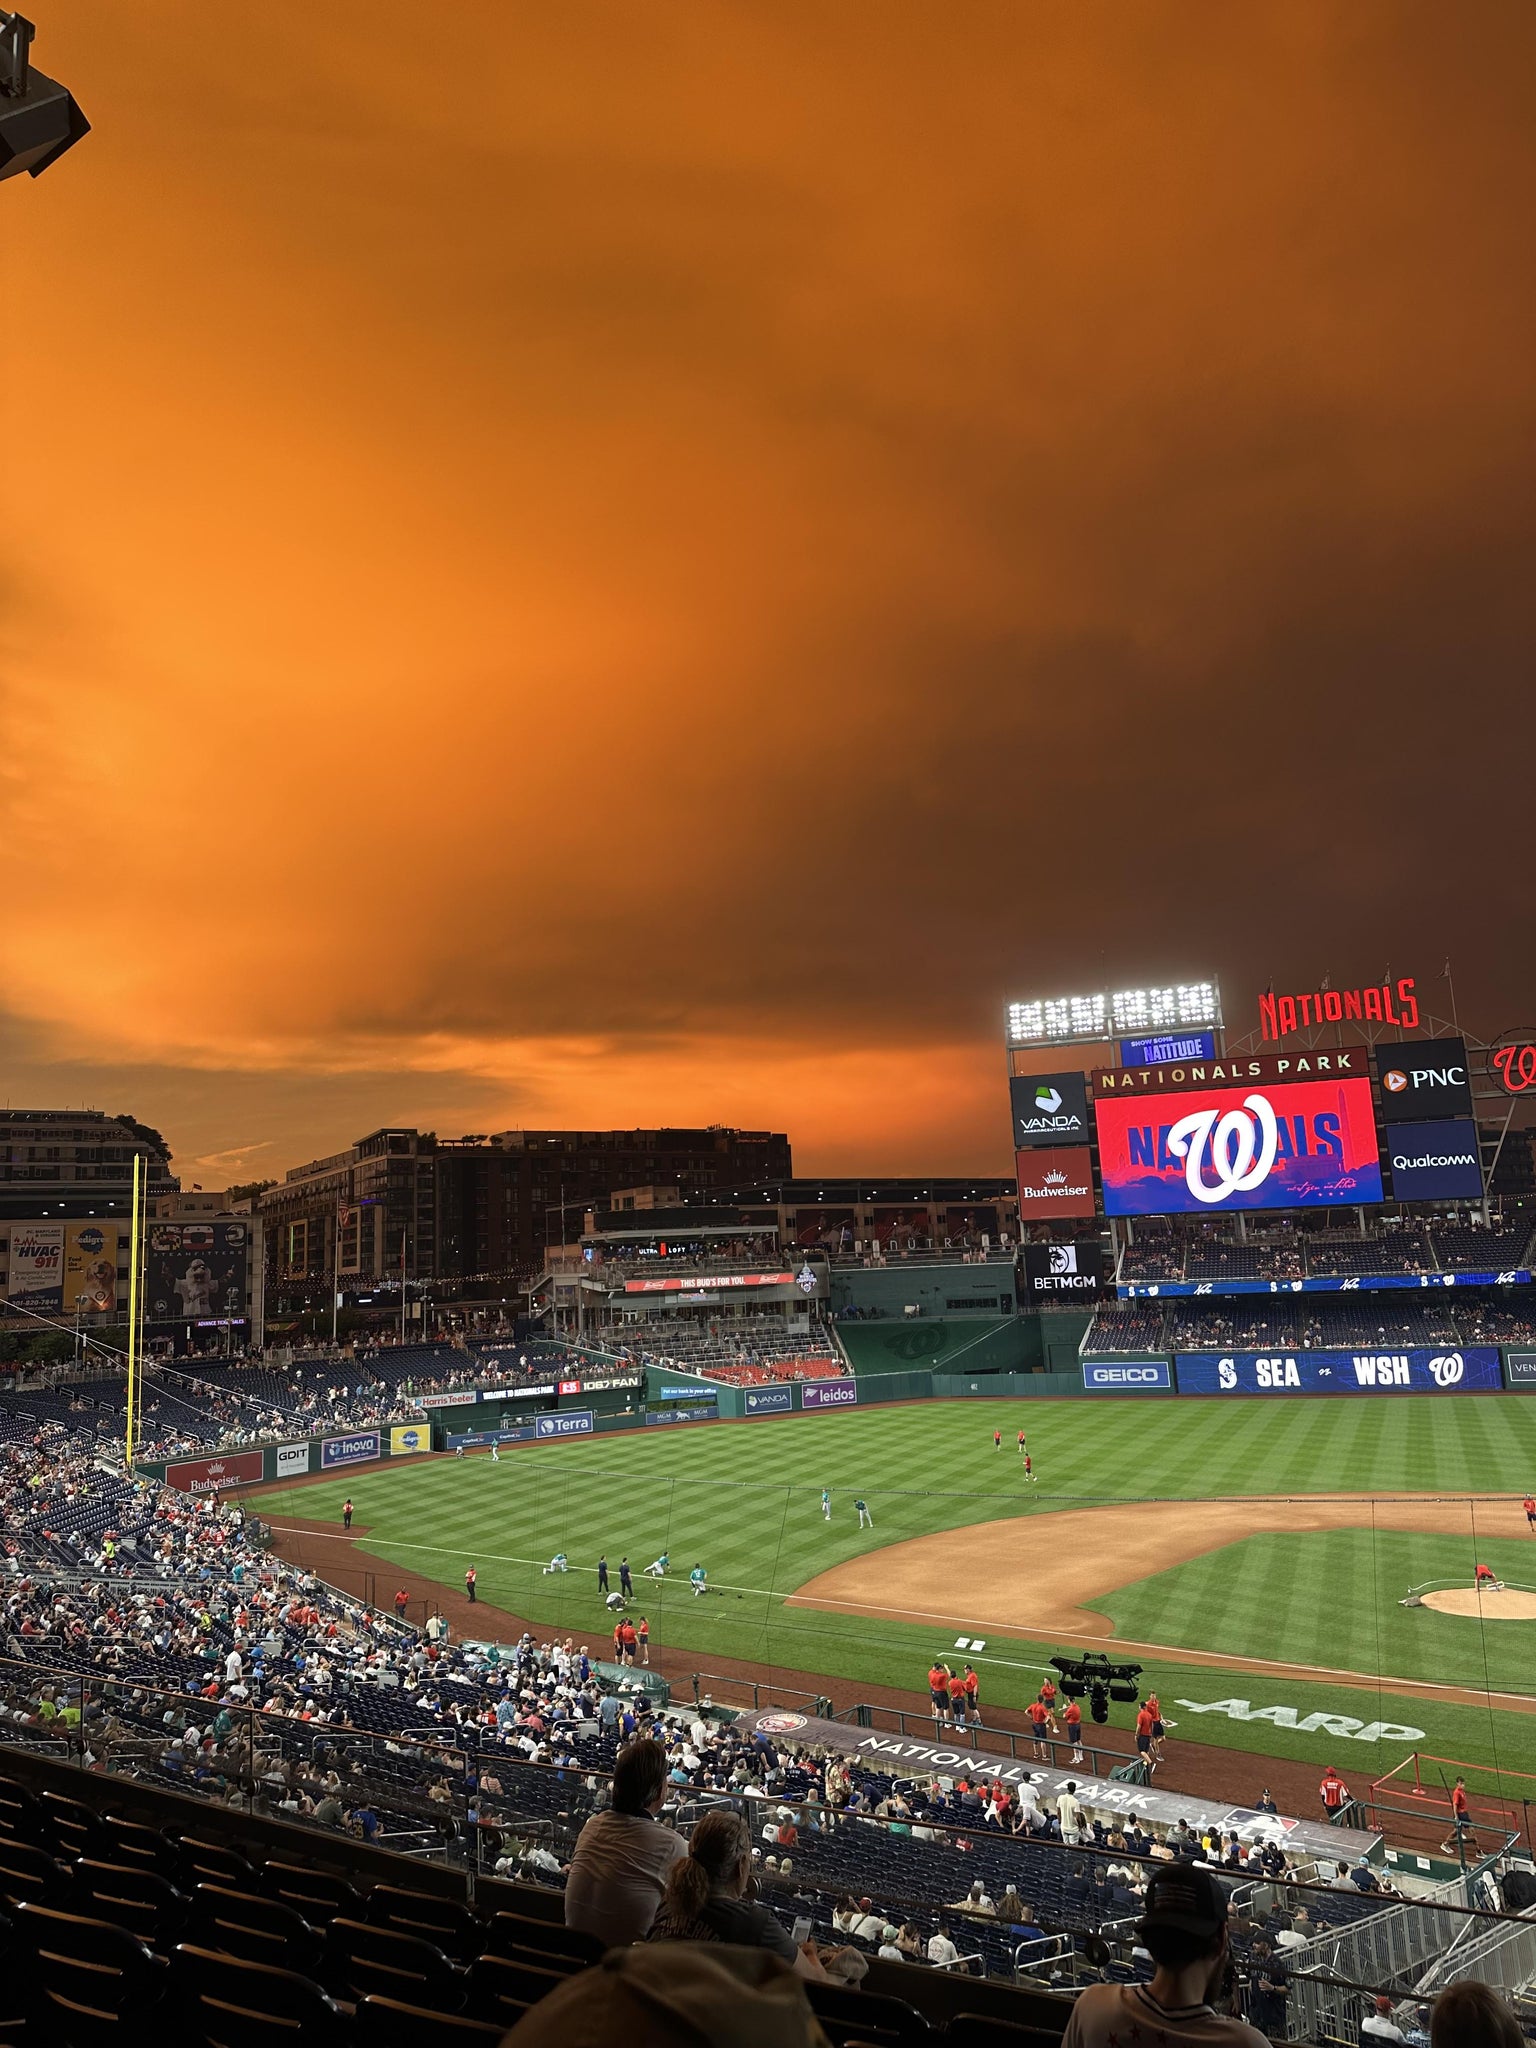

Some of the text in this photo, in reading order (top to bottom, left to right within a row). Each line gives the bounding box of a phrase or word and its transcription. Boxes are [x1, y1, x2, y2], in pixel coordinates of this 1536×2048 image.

[1258, 978, 1419, 1041] NATIONALS
[1131, 1036, 1173, 1047] SHOW SOME
[1144, 1039, 1203, 1062] NATITUDE
[1102, 1054, 1352, 1088] NATIONALS PARK
[1410, 1067, 1466, 1089] PNC
[1020, 1115, 1081, 1129] VANDA
[1127, 1112, 1342, 1171] NAALS
[1393, 1154, 1476, 1170] Qualcomm
[1024, 1186, 1088, 1198] Budweiser
[19, 1246, 60, 1257] HVAC
[34, 1257, 60, 1268] 911
[680, 1277, 746, 1287] THIS BUD'S FOR YOU.
[1034, 1276, 1096, 1289] BETMGM
[1093, 1368, 1159, 1382] GEICO
[1255, 1358, 1301, 1387] SEA
[1353, 1356, 1411, 1386] WSH
[613, 1377, 638, 1388] FAN
[483, 1385, 554, 1400] WELCOME TO NATIONALS PARK
[757, 1394, 788, 1403] VANDA
[820, 1386, 855, 1402] leidos
[422, 1394, 474, 1406] Harris Teeter
[555, 1419, 588, 1431] Terra
[342, 1439, 374, 1454] inova
[278, 1449, 307, 1461] GDIT
[190, 1475, 241, 1491] Budweiser
[1173, 1698, 1427, 1742] AARP
[858, 1736, 1160, 1809] NATIONALS PARK
